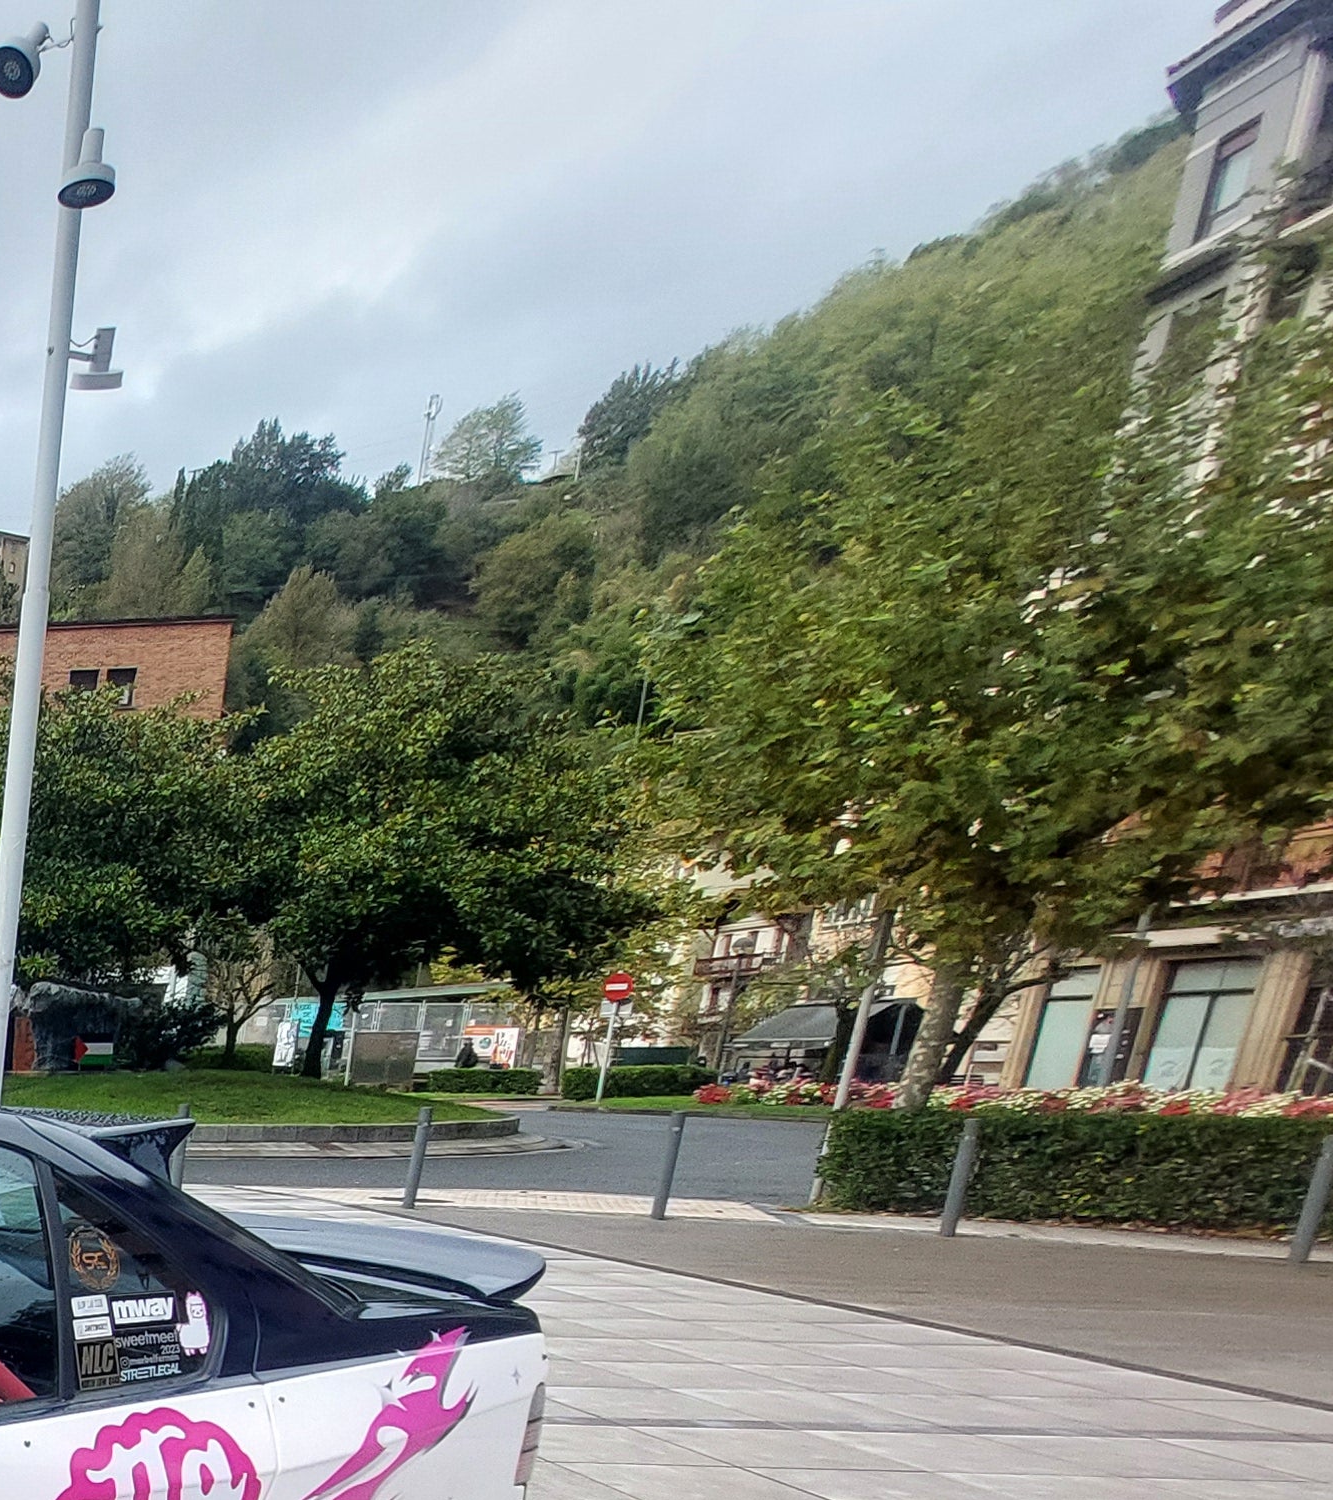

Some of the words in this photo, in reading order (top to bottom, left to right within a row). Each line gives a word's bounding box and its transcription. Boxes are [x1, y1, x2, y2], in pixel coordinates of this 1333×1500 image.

[112, 1297, 173, 1324] mway
[115, 1329, 180, 1348] sweetmeet
[81, 1342, 114, 1375] NLC
[159, 1343, 181, 1355] 2023
[120, 1363, 181, 1381] STREETLEGAL
